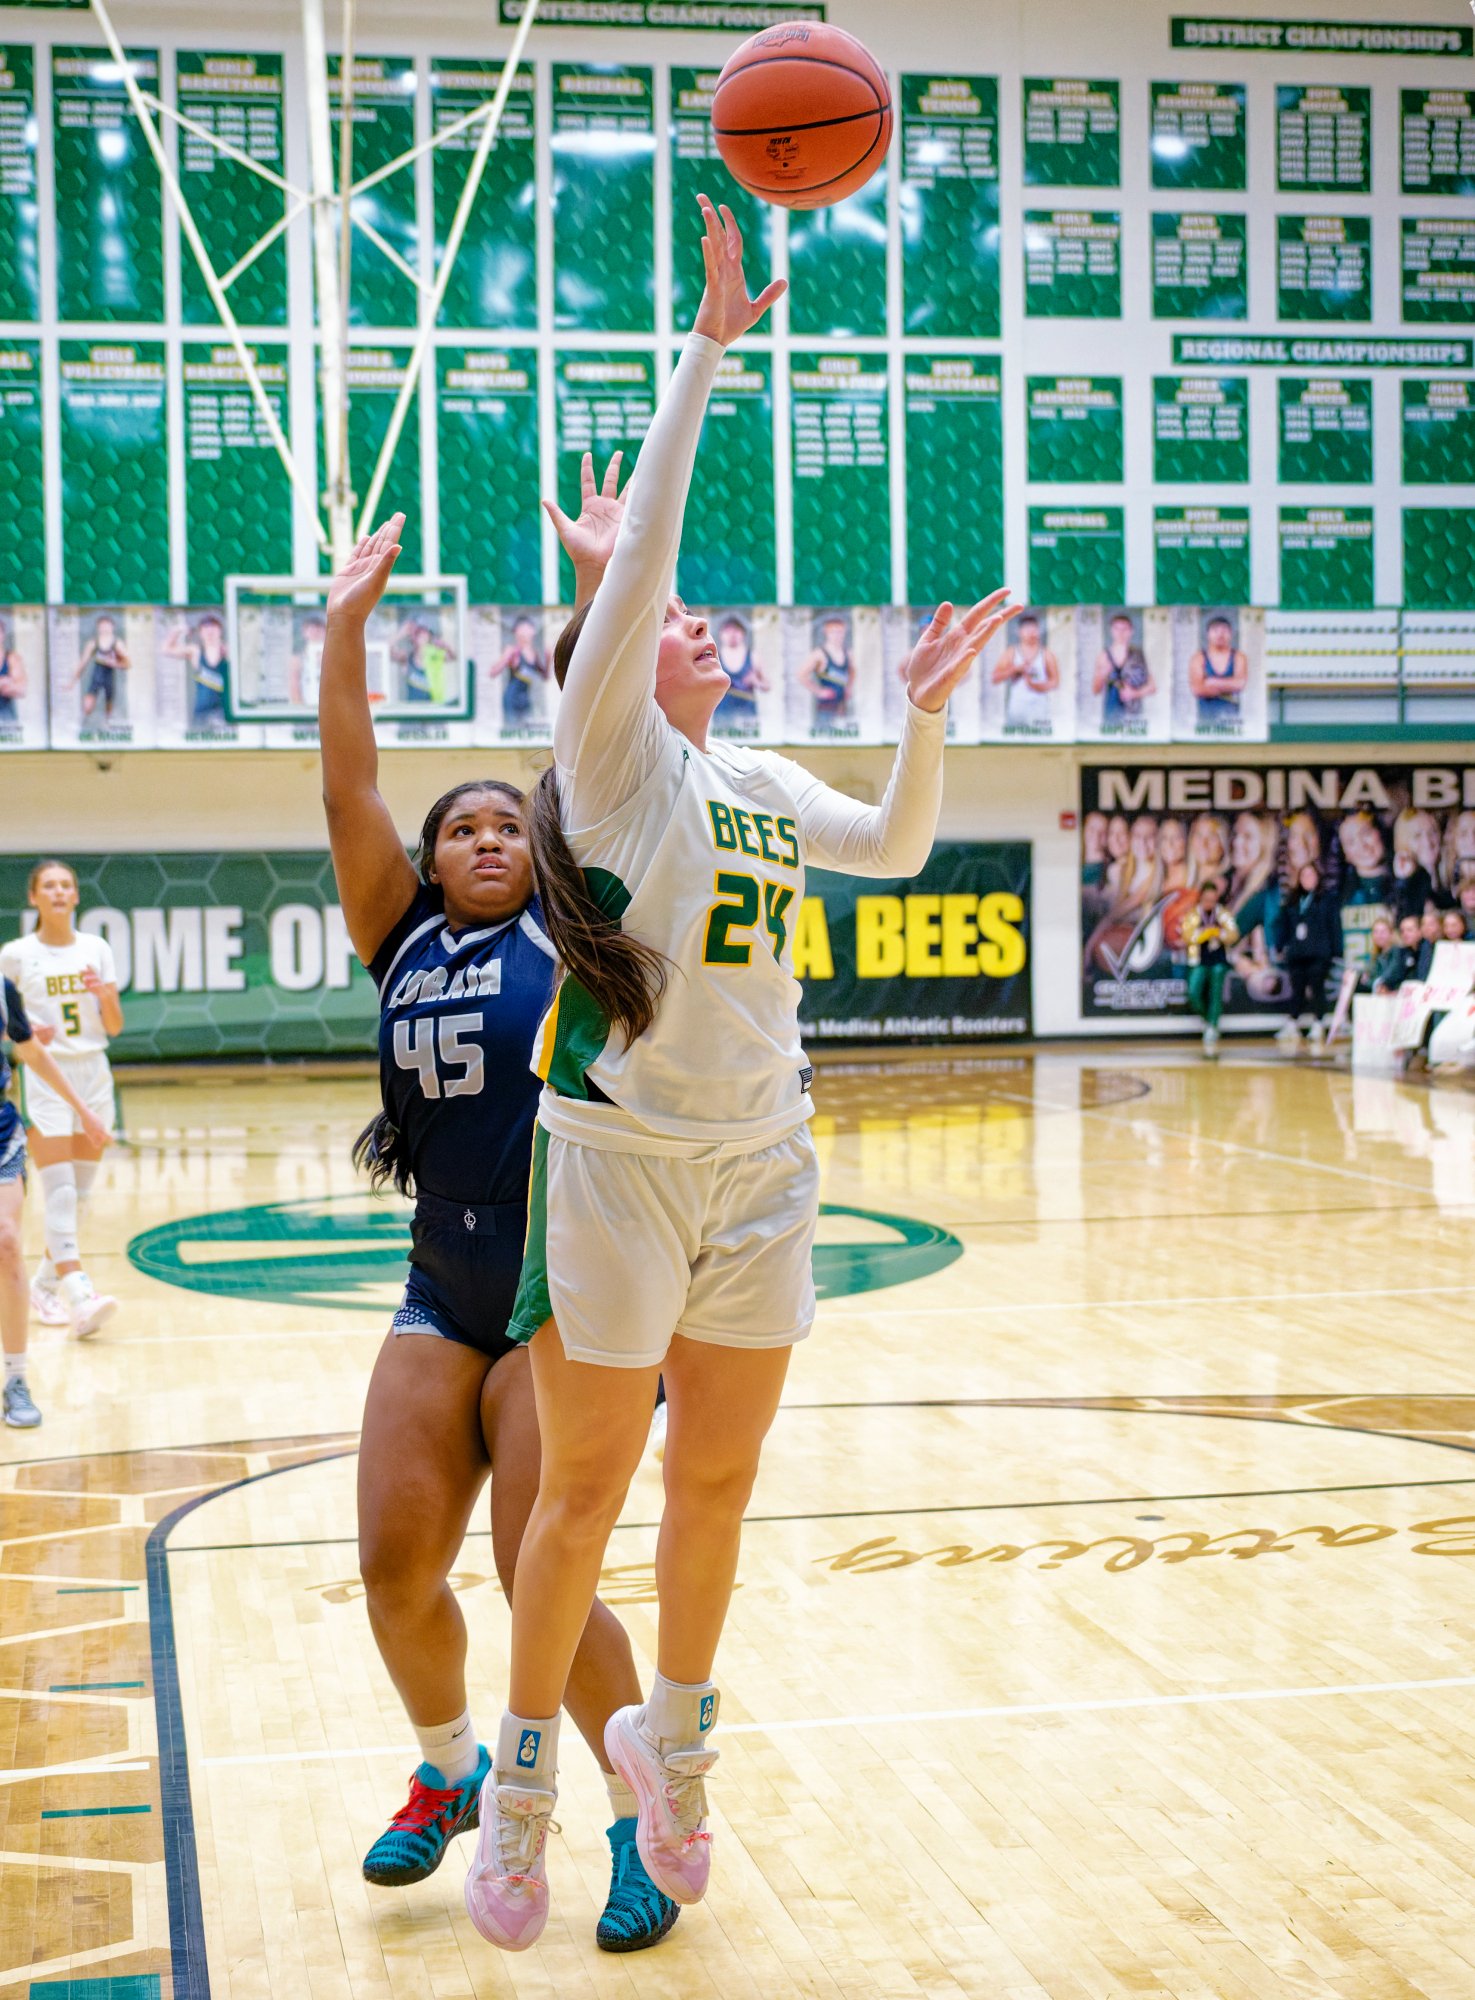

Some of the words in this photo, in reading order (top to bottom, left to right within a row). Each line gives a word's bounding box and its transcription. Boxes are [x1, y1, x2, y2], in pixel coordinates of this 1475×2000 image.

[504, 0, 644, 22] CNFERENCE
[1183, 23, 1284, 45] DISTRICT
[1286, 26, 1462, 51] CHAMPIONSHIPS
[90, 346, 137, 363] GIRLS
[212, 348, 258, 364] BOS
[1181, 339, 1287, 360] REGIONAL
[1290, 342, 1466, 362] CHAMPIONSHIPS
[62, 363, 164, 380] VOLLEYBALL
[185, 364, 287, 382] BASKETALL
[1098, 769, 1391, 811] MEDINA
[706, 799, 799, 870] BEES
[702, 869, 796, 967] 24
[856, 892, 1026, 980] BEES
[388, 958, 501, 1008] LORAIN
[61, 1002, 81, 1037] 5
[818, 1018, 882, 1037] Medina
[882, 1015, 950, 1036] Athletic
[951, 1015, 1027, 1035] Boosters
[393, 1012, 485, 1099] 45
